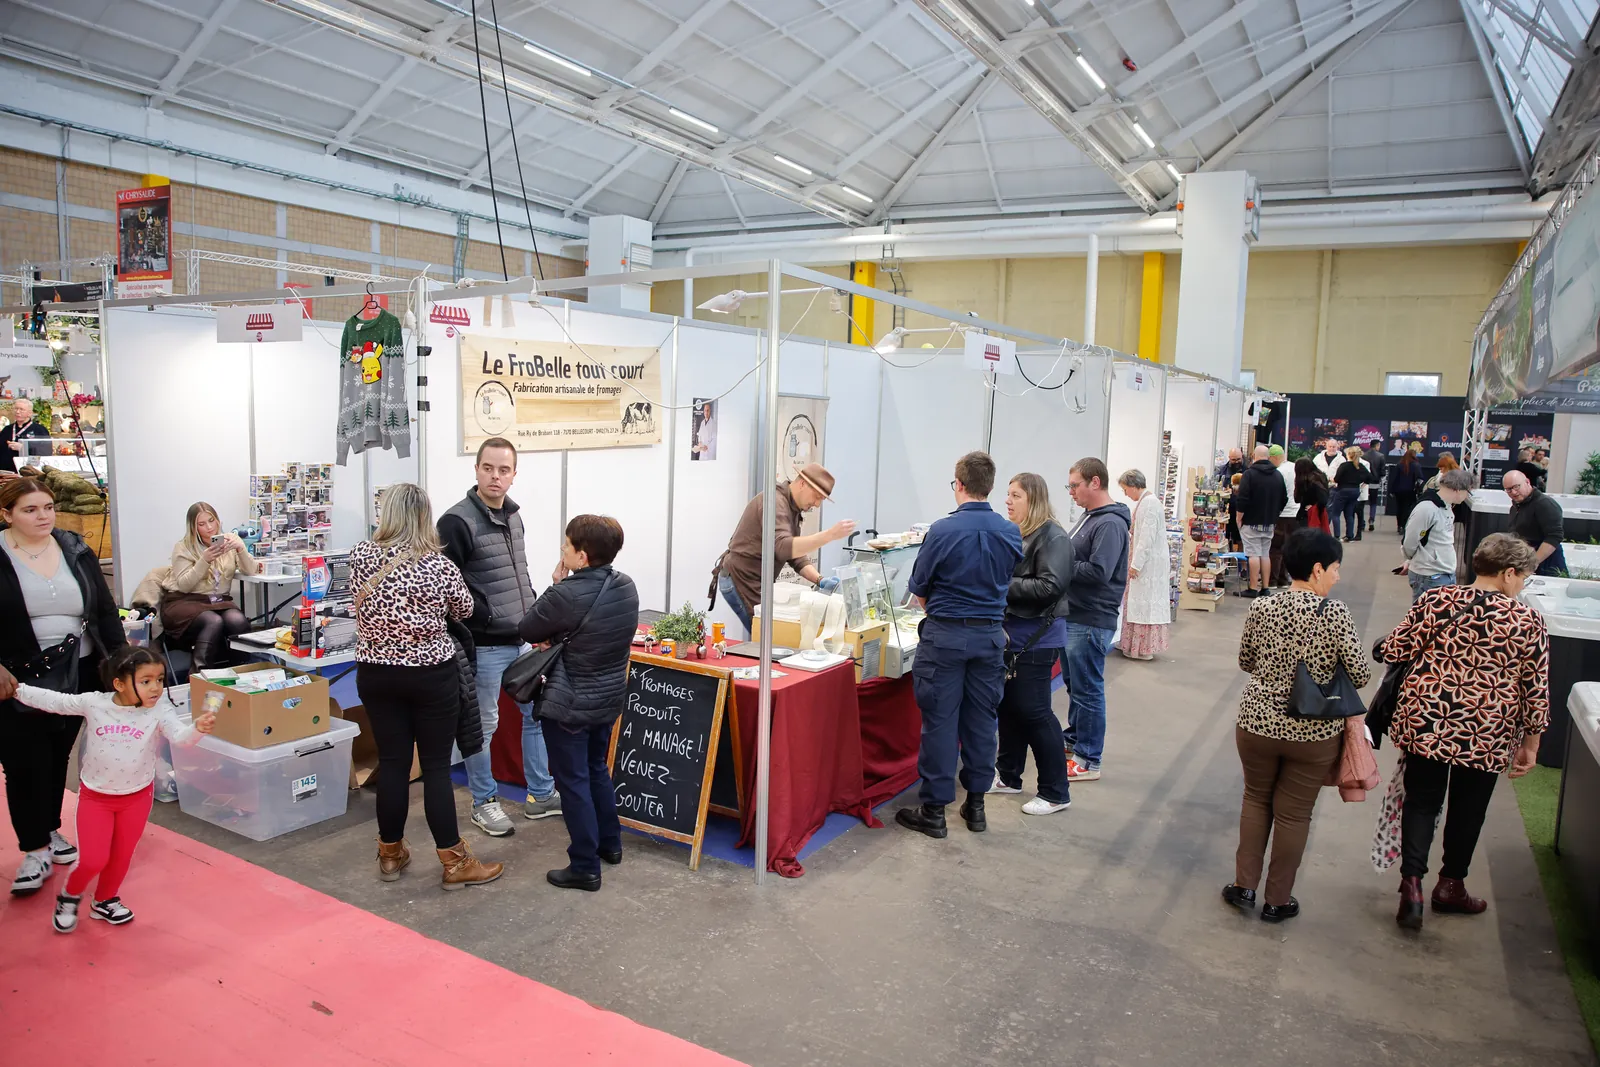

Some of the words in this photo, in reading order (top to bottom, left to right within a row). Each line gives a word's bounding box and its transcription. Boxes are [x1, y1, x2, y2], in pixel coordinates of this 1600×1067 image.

[126, 189, 156, 200] CHRYSALIDE
[482, 350, 504, 375] Le
[508, 353, 571, 378] FroBelle
[576, 361, 606, 380] tout
[610, 363, 644, 380] court
[513, 382, 554, 392] Fabrication
[554, 384, 586, 394] artisanale
[588, 385, 594, 394] de
[596, 384, 622, 396] fromages
[1520, 396, 1544, 409] plus
[1546, 397, 1558, 406] de
[1560, 398, 1574, 406] 15
[1576, 400, 1598, 408] ans
[640, 668, 694, 702] FROMAGES
[96, 724, 144, 740] CHIPIE
[624, 722, 632, 738] A
[620, 748, 670, 785] VENEZ
[300, 776, 316, 788] 145
[614, 782, 664, 818] GOUTER
